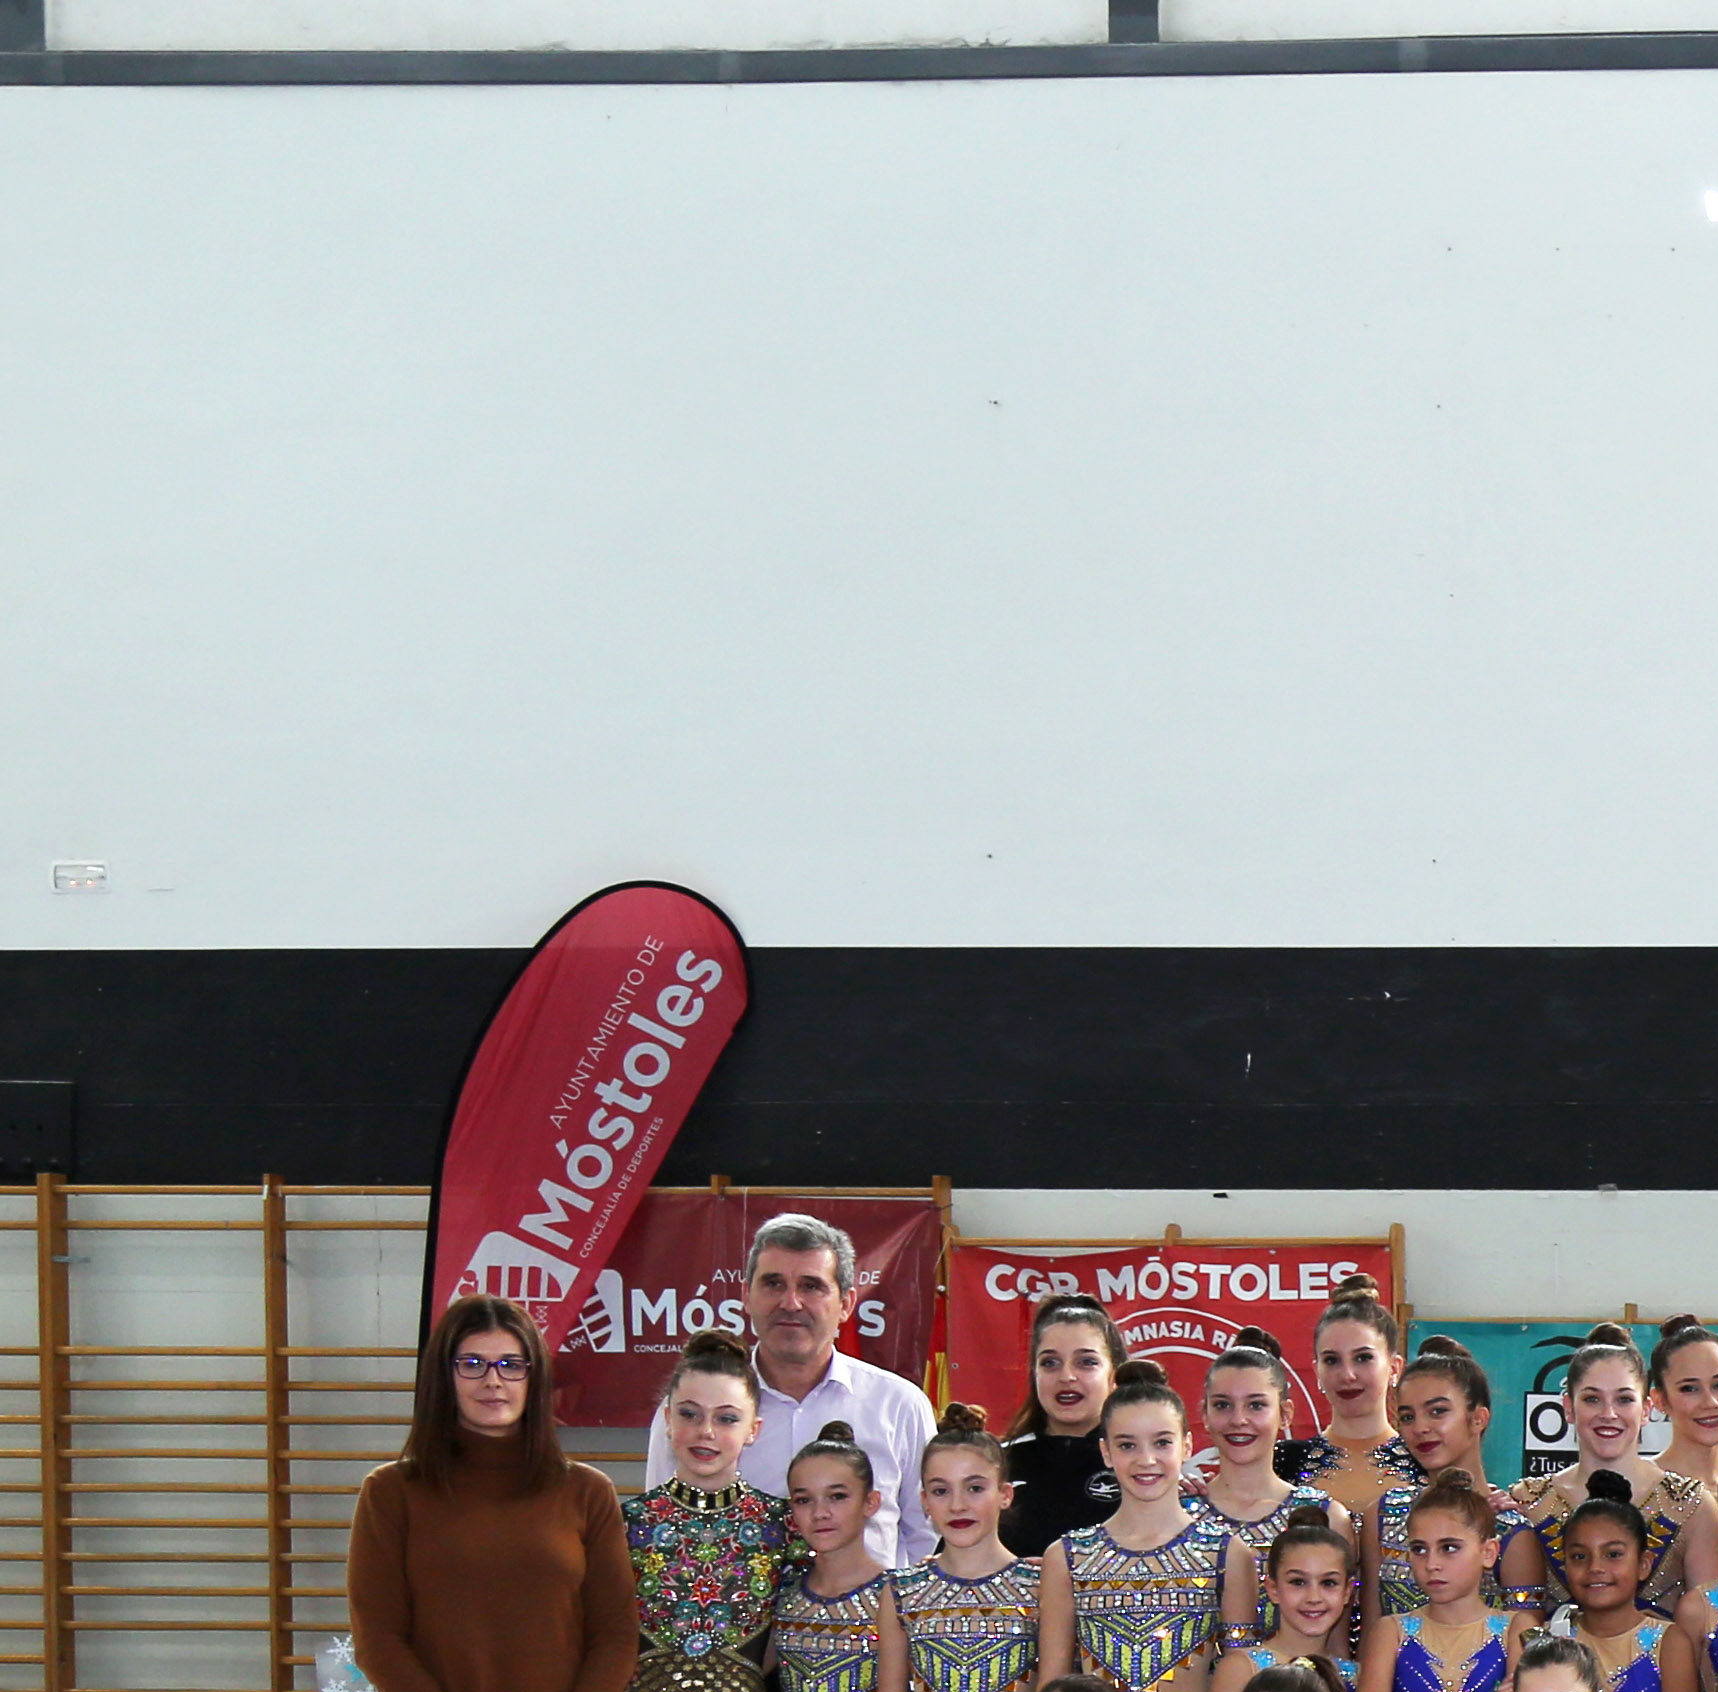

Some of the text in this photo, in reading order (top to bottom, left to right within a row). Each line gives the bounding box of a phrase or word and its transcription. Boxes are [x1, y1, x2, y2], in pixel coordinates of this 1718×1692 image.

[517, 949, 724, 1252] Móstoles
[550, 935, 665, 1130] AYUNTAMIENTO DE
[579, 1116, 664, 1259] CONCEJALÍA DE DEPORTES
[858, 1270, 882, 1286] DE
[1119, 1319, 1206, 1346] MNASIA
